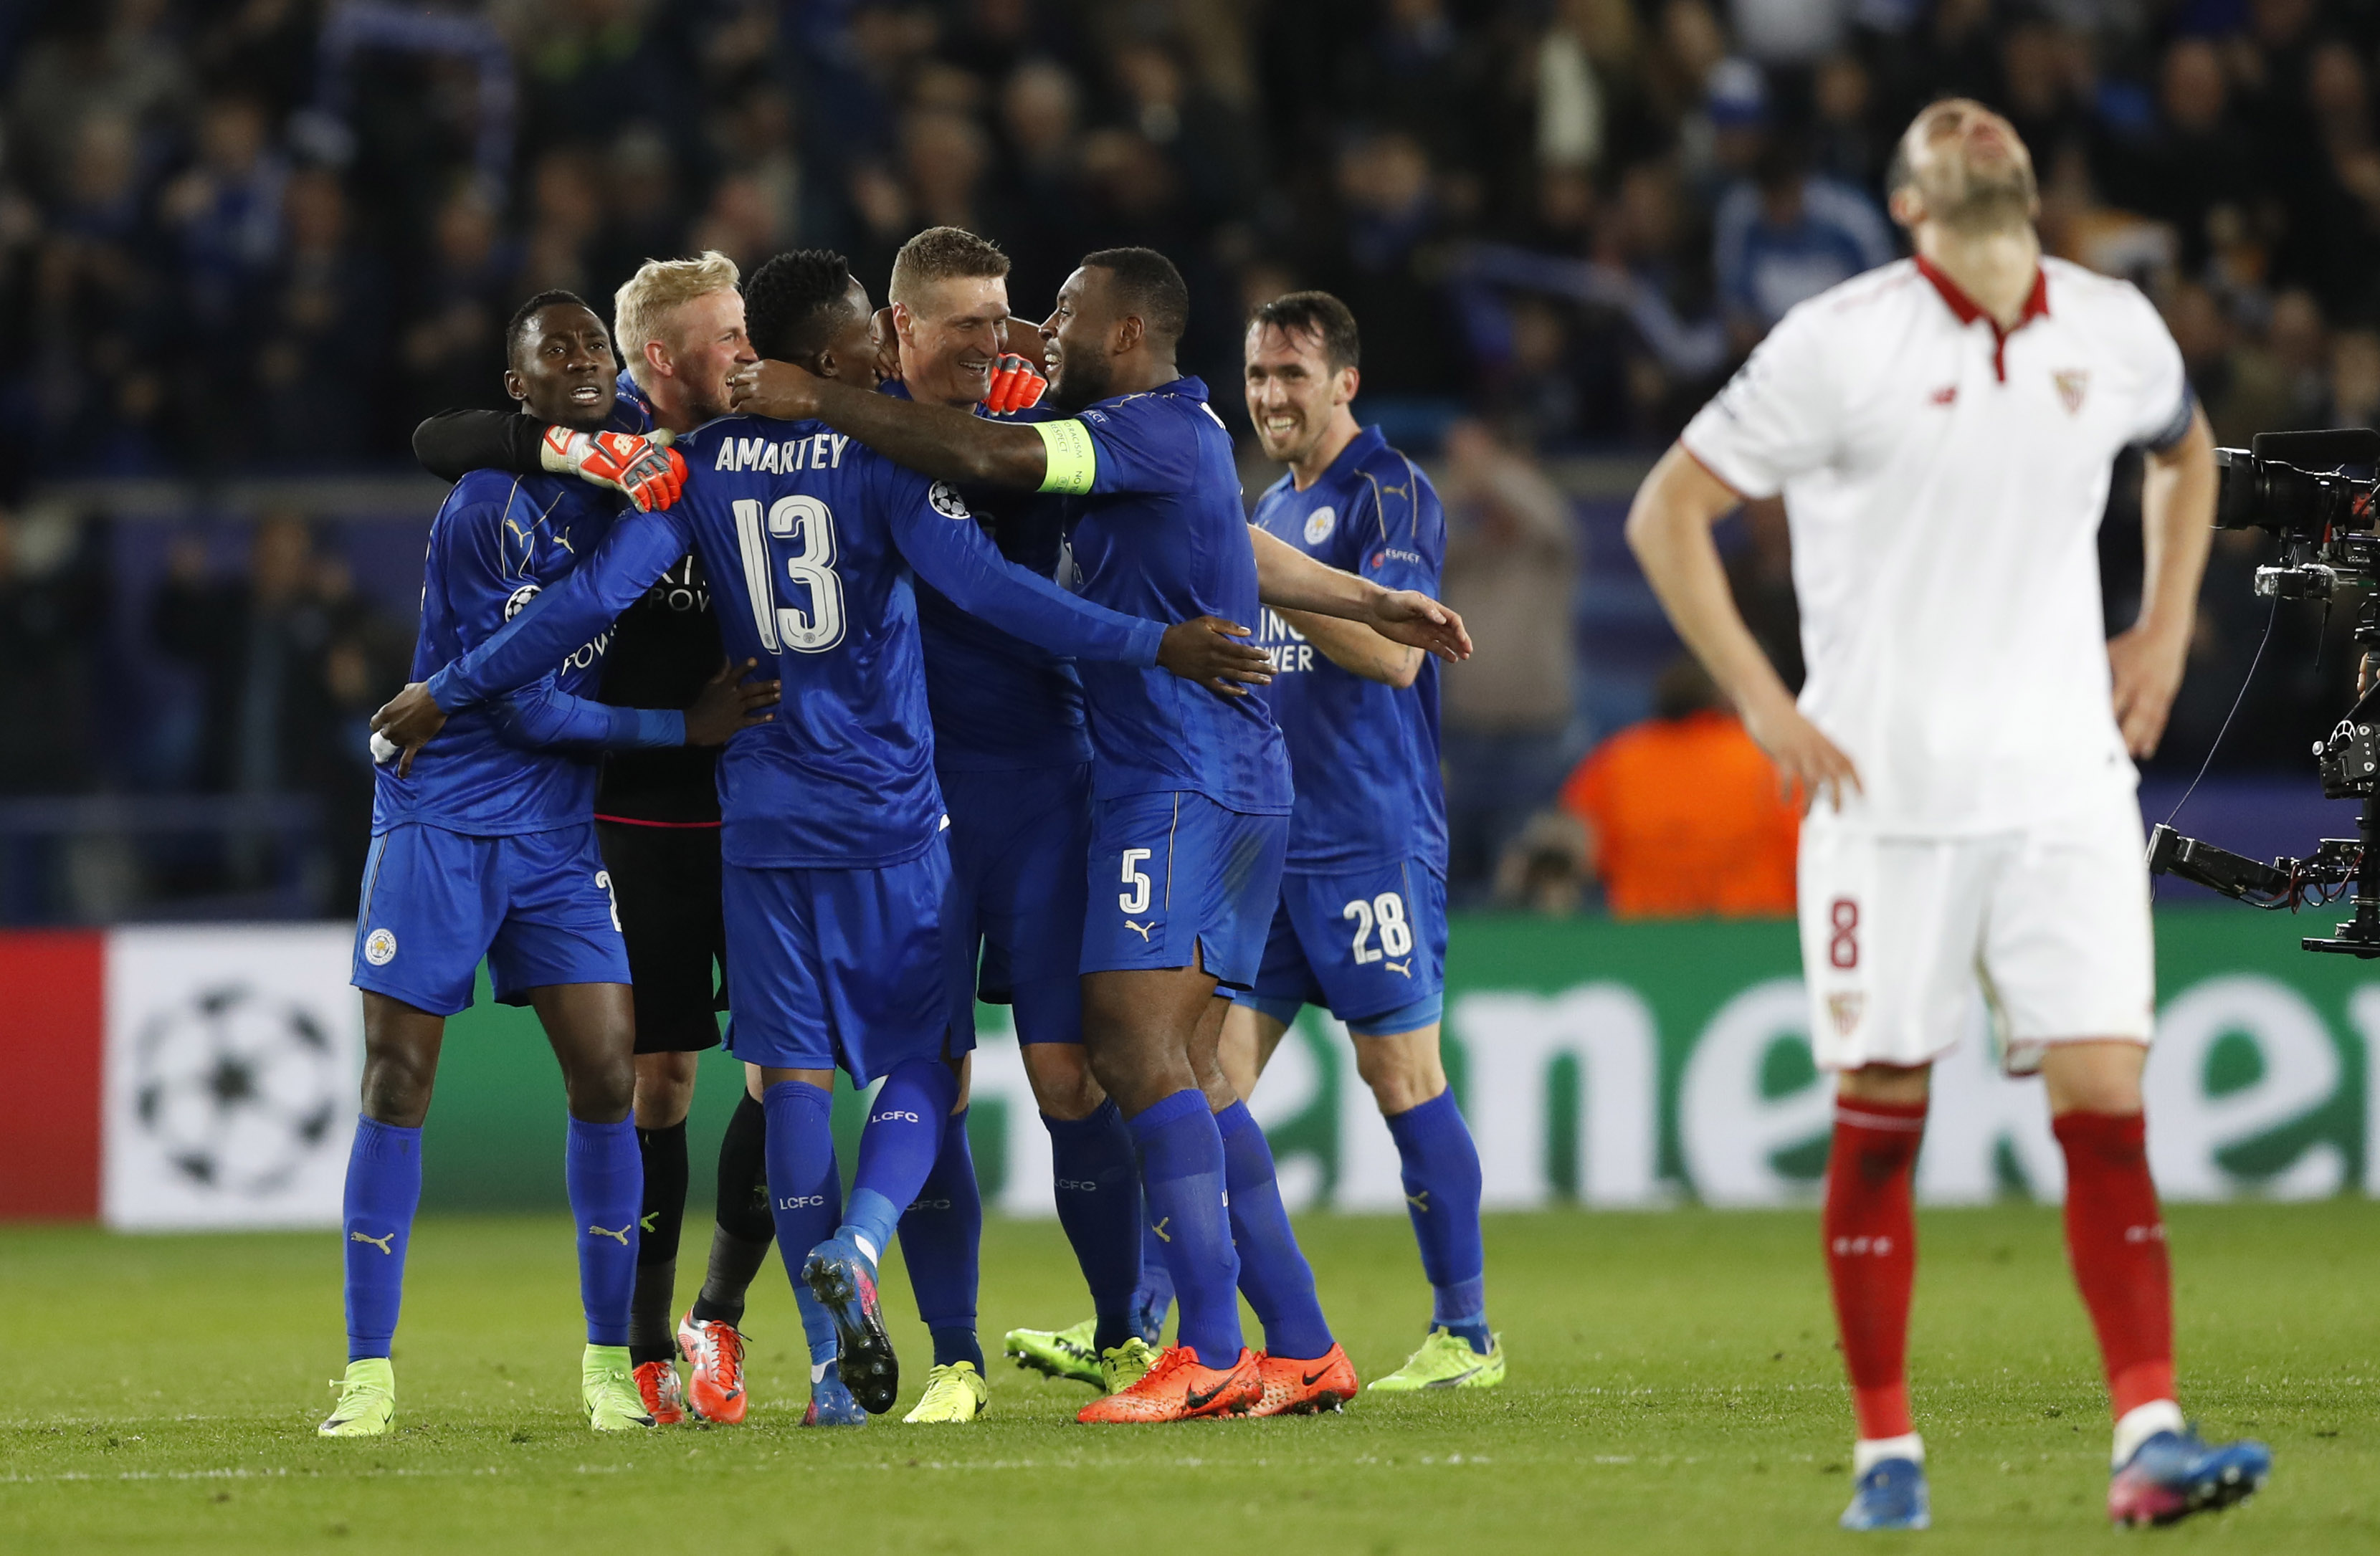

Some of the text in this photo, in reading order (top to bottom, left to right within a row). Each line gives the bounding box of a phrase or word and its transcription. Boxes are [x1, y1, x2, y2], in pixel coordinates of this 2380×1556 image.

[715, 433, 849, 474] AMARTEY
[1068, 428, 1082, 458] RACISM
[1073, 470, 1082, 485] NO
[1385, 548, 1420, 564] ESPECT
[732, 495, 847, 654] 13
[1119, 848, 1151, 915] 5
[1343, 892, 1413, 965] 28
[1831, 899, 1858, 969] 8
[872, 1111, 918, 1123] LCFC
[779, 1195, 824, 1211] LCFC
[906, 1198, 951, 1211] CFC
